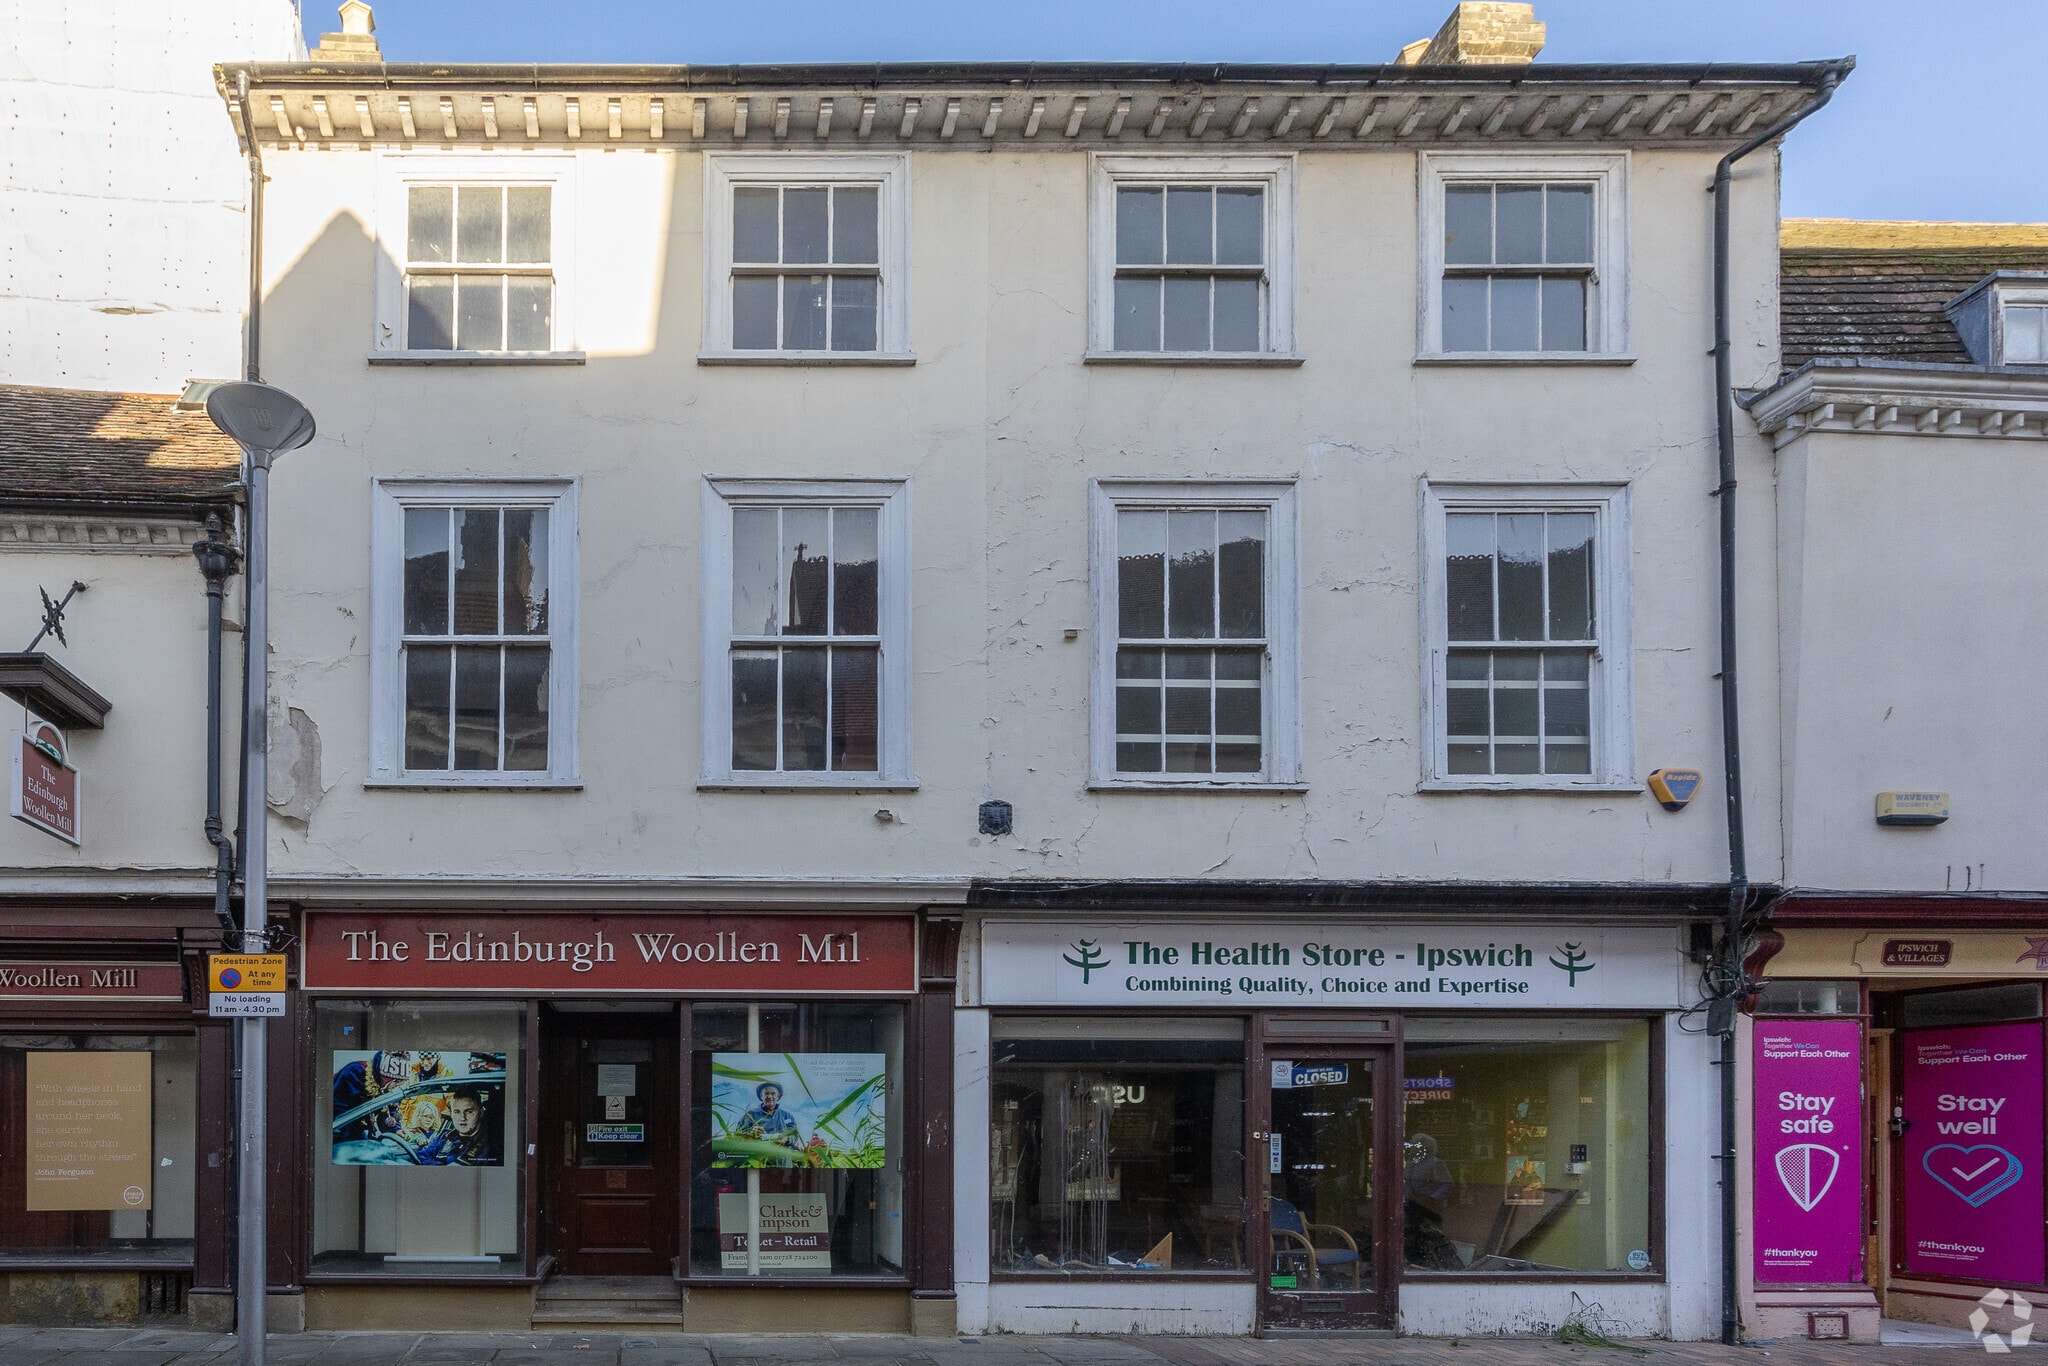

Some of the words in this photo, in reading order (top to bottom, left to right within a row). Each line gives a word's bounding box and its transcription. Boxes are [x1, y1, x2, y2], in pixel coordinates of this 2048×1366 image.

[41, 765, 56, 785] The
[28, 776, 68, 812] Edinburgh
[23, 795, 55, 824] Woollen
[56, 813, 72, 832] Mill
[341, 930, 409, 962] The
[425, 930, 616, 972] Edinburgh
[632, 931, 781, 963] Woollen
[797, 931, 861, 963] Mil
[1897, 944, 1939, 952] IPSWICH
[213, 957, 259, 965] Pedestrian
[261, 957, 283, 965] Zone
[1123, 941, 1179, 965] The
[1191, 942, 1290, 966] Health
[1302, 942, 1385, 967] Store
[1416, 943, 1533, 972] Ipswich
[1887, 954, 1896, 962] &
[1898, 954, 1946, 962] VILLAGES
[0, 968, 81, 988] Woollen
[90, 968, 137, 988] Mill
[248, 970, 258, 978] At
[260, 971, 276, 979] any
[252, 978, 272, 986] time
[1125, 975, 1233, 996] Combining
[1238, 976, 1314, 996] Quality,
[1321, 977, 1388, 994] Choice
[1394, 977, 1431, 994] and
[1438, 977, 1529, 997] Expertise
[224, 995, 237, 1003] No
[239, 995, 271, 1004] loading
[243, 1005, 265, 1013] 4.30
[1763, 1050, 1798, 1059] Support
[1800, 1050, 1823, 1058] Each
[1824, 1050, 1850, 1058] Other
[1918, 1056, 1961, 1065] Support
[1962, 1054, 1991, 1062] Each
[1993, 1053, 2028, 1061] Other
[1296, 1071, 1343, 1084] CLOSED
[66, 1084, 100, 1092] wheels
[103, 1084, 112, 1092] in
[116, 1084, 142, 1092] hand
[58, 1099, 119, 1107] headphones
[1779, 1091, 1835, 1115] Stay
[1937, 1094, 2006, 1115] Stay
[36, 1112, 72, 1120] around
[75, 1112, 92, 1120] her
[36, 1125, 53, 1133] she
[1781, 1115, 1834, 1133] safe
[1937, 1117, 1996, 1134] well
[36, 1139, 54, 1147] her
[80, 1139, 119, 1148] rhythm
[36, 1153, 76, 1162] through
[58, 1168, 94, 1176] Ferguson
[760, 1205, 807, 1218] Clarke
[784, 1236, 818, 1247] Retail
[1918, 1241, 1985, 1253] #thankyou
[1764, 1248, 1818, 1258] #thankyou
